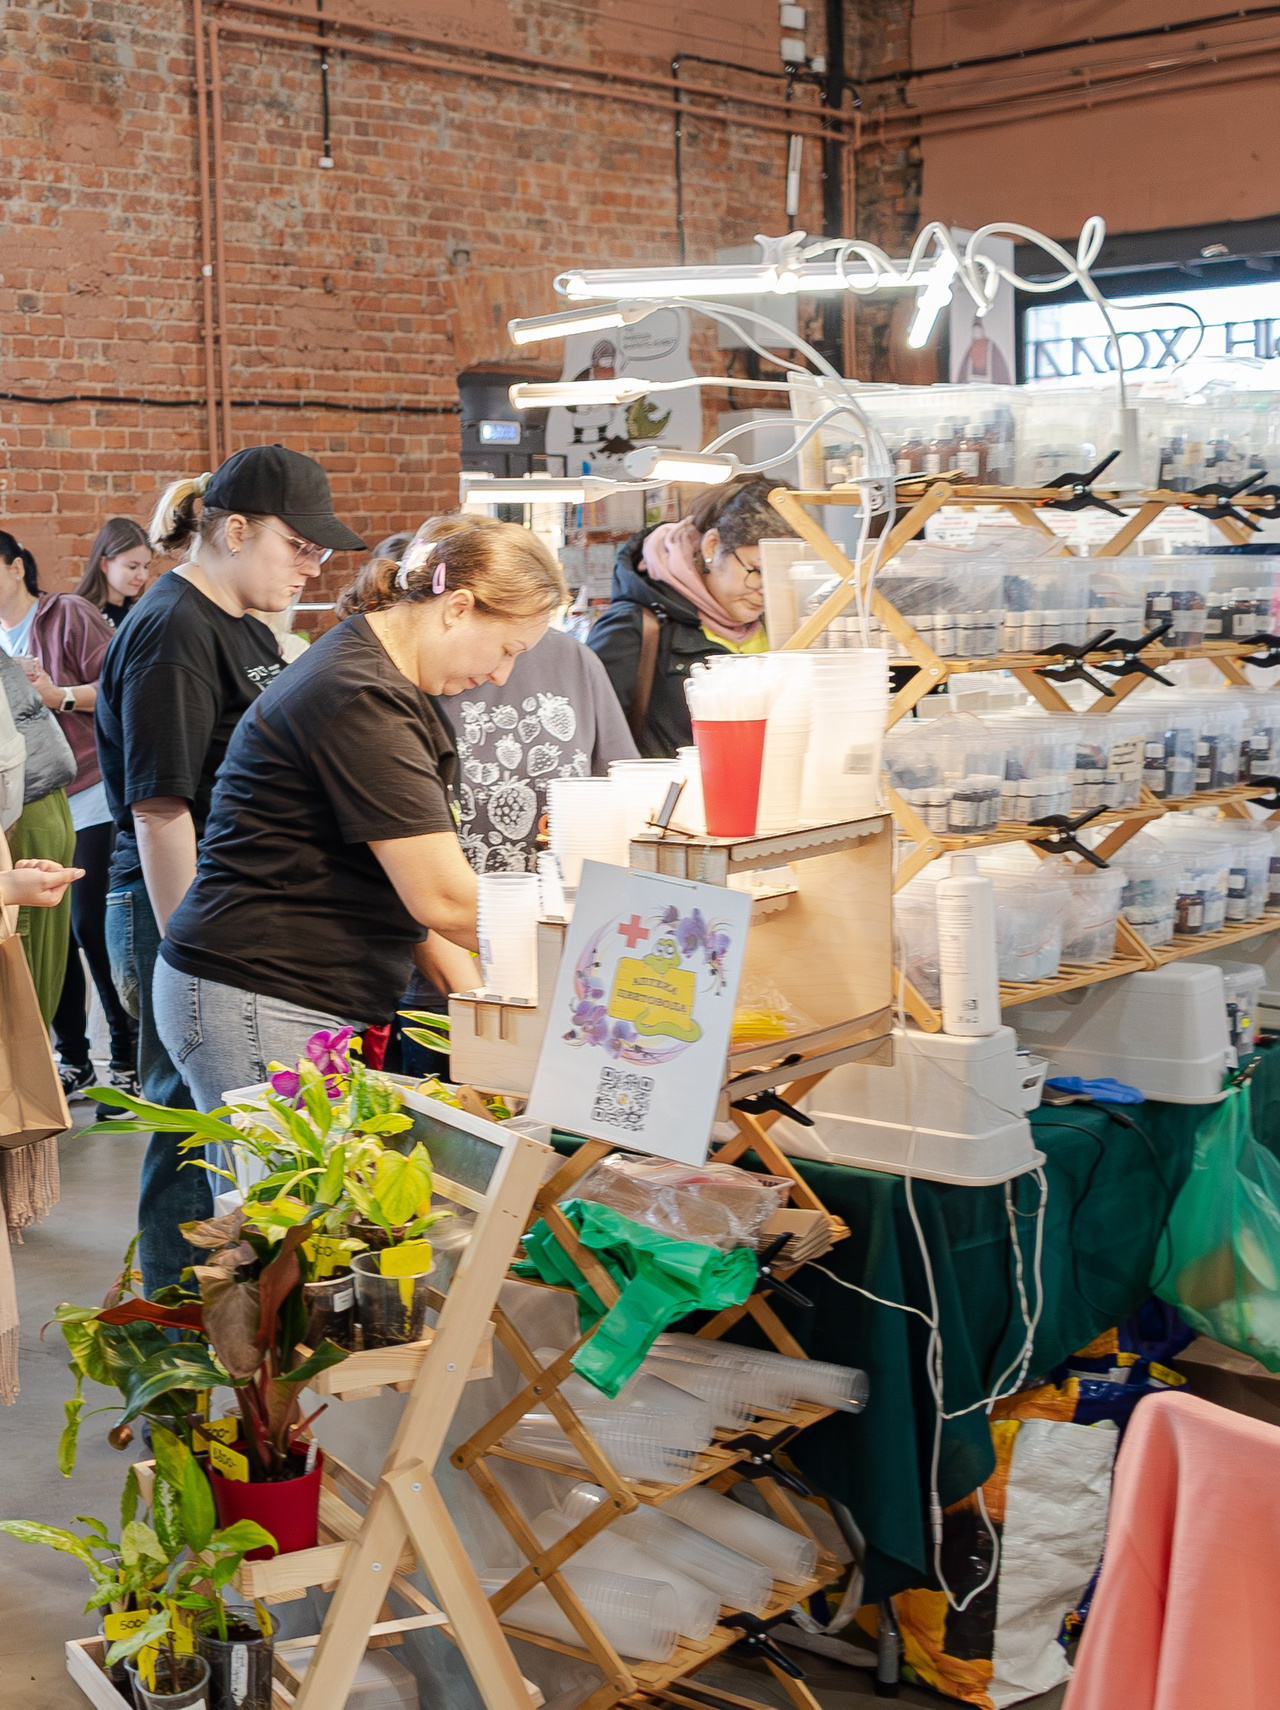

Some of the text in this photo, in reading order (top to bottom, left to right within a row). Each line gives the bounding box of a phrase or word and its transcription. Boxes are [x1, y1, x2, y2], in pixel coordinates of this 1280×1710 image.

[632, 977, 677, 995] АПТЕКА
[616, 989, 687, 1012] ЦВЕТОВОДА
[120, 1618, 146, 1631] 500-
